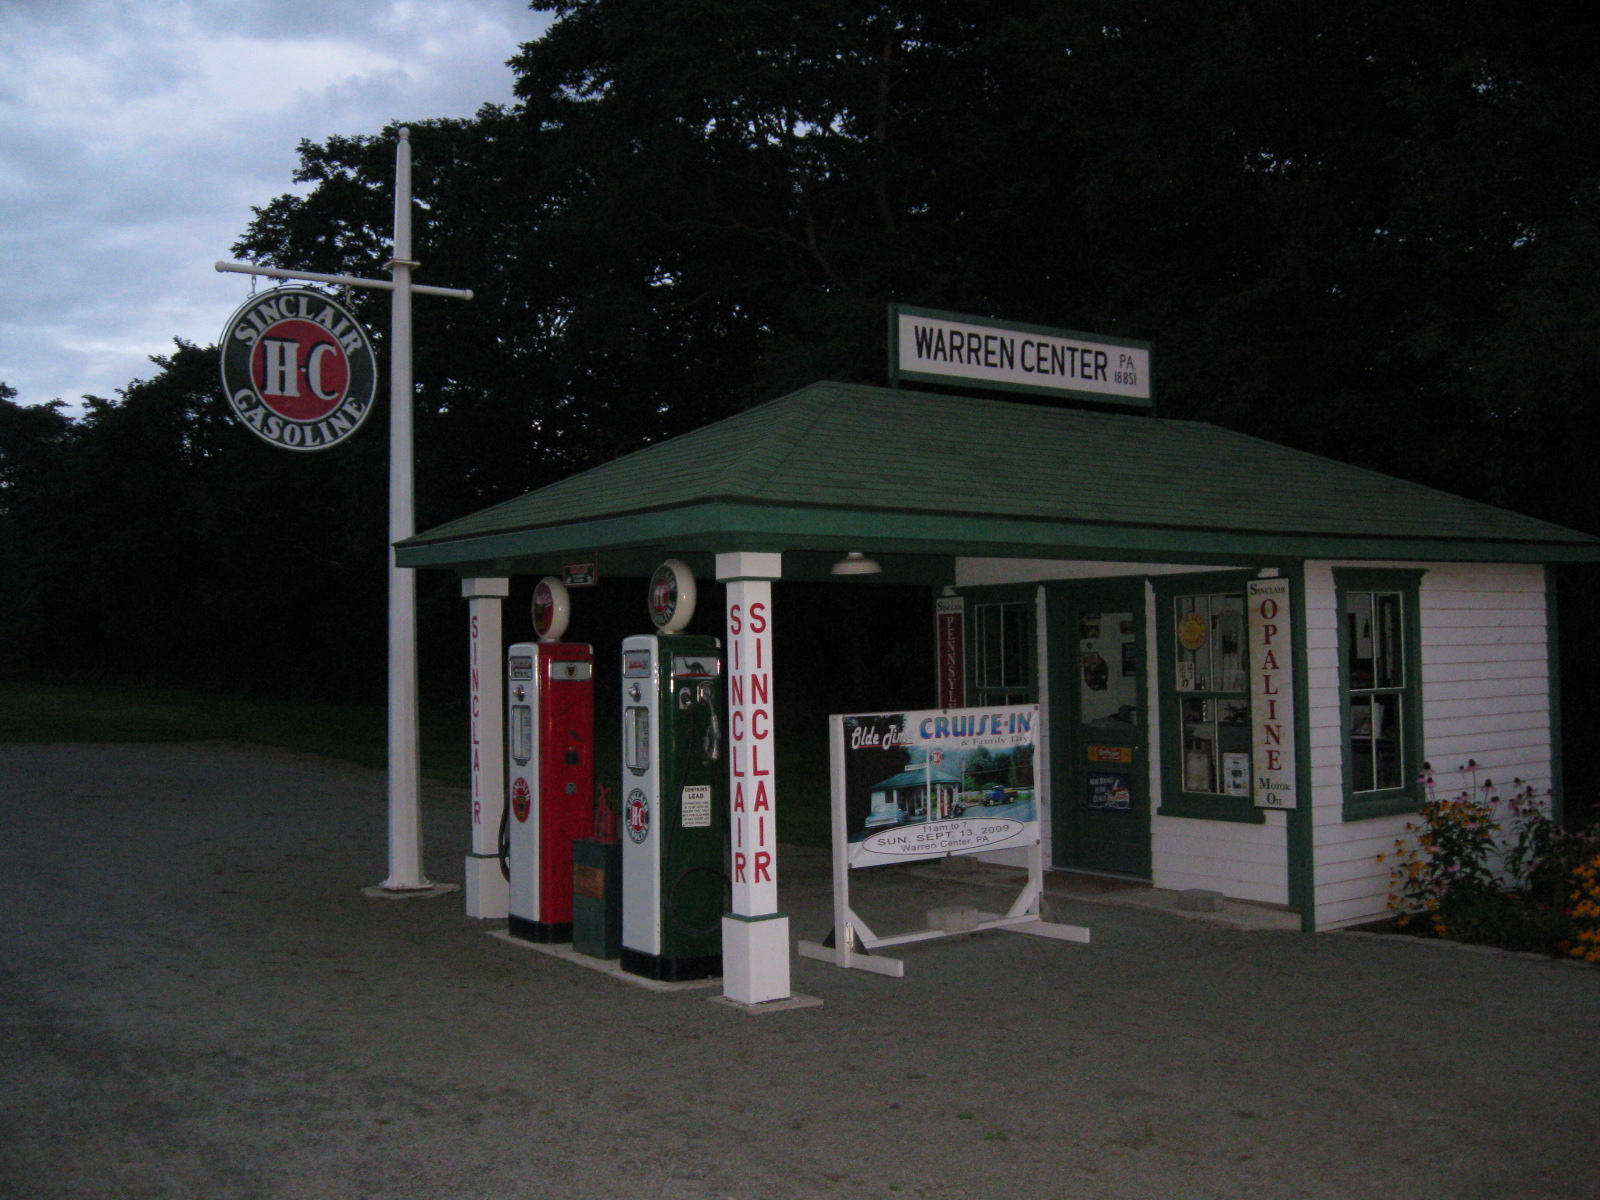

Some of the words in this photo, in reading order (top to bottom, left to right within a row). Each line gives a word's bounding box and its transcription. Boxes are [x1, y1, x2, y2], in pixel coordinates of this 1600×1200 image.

[234, 295, 363, 356] SINCLAIR
[914, 325, 1015, 370] WARREN
[1020, 340, 1108, 382] CENTER
[1114, 370, 1138, 386] 18851
[233, 388, 366, 447] GASOLINE
[1260, 598, 1283, 771] OPALINE
[471, 616, 482, 825] SINCLAIR
[730, 604, 747, 884] SINCLAIR
[749, 602, 772, 883] SINCLAIR
[851, 726, 880, 750] Olde
[901, 841, 937, 852] Warren
[976, 835, 989, 843] PA
[981, 824, 1011, 835] 2009
